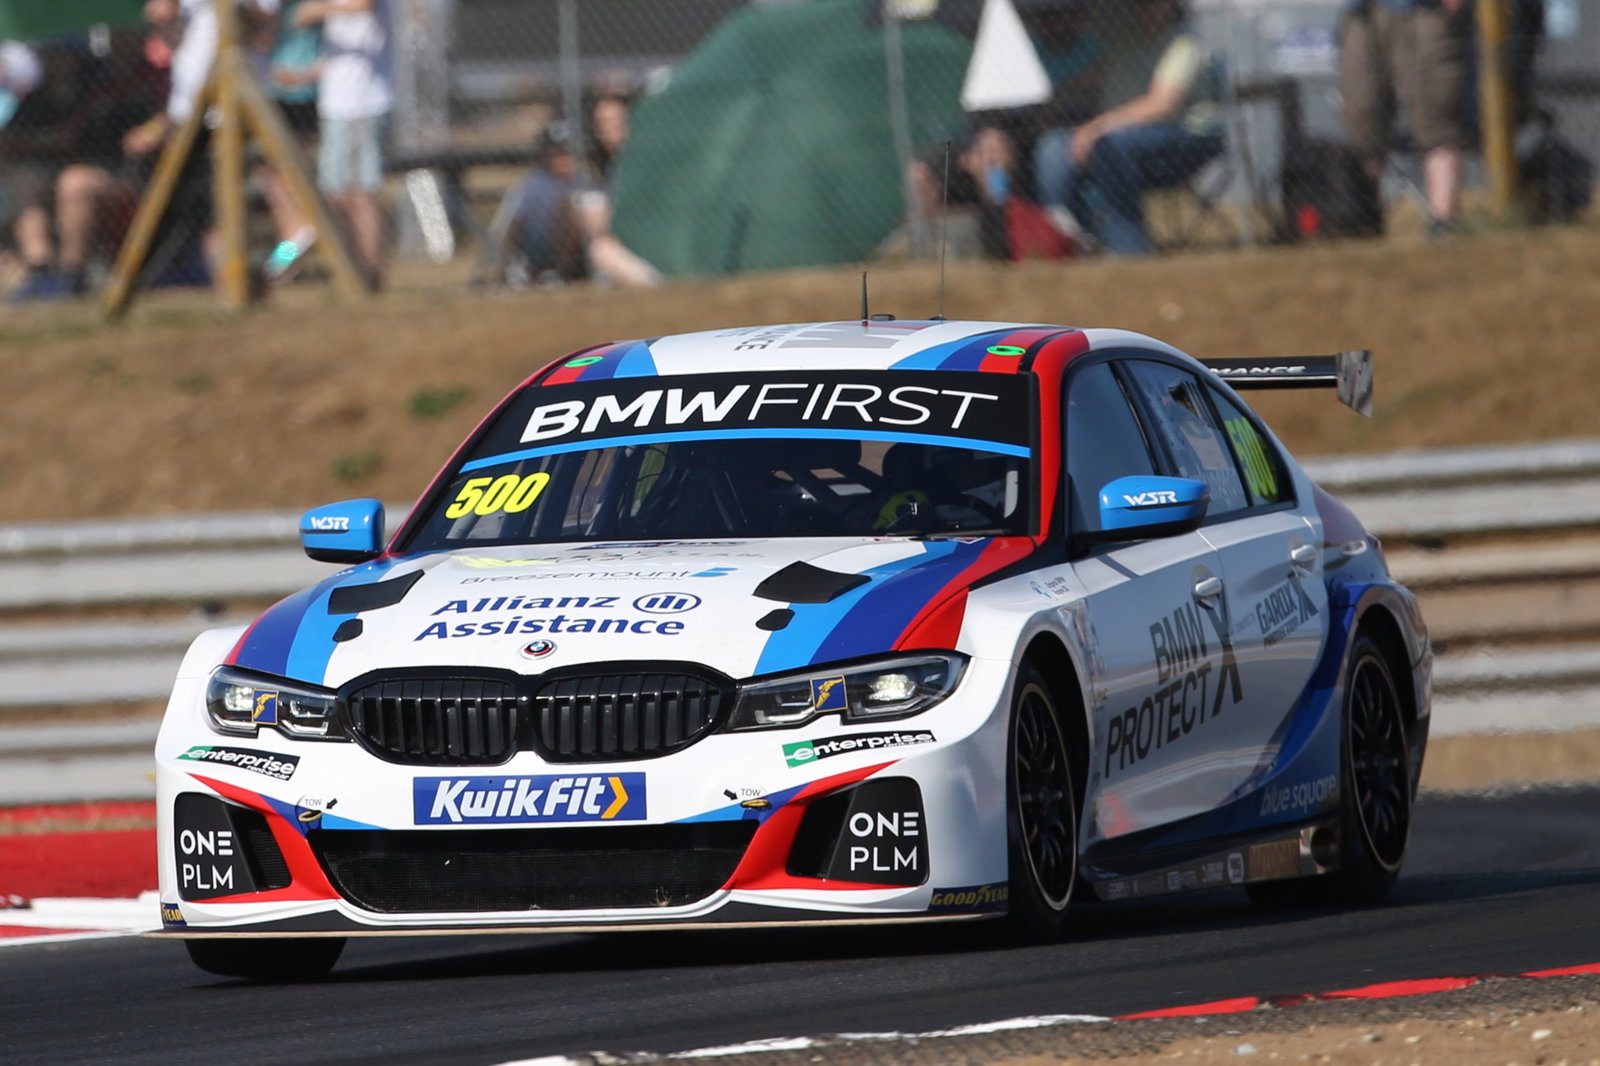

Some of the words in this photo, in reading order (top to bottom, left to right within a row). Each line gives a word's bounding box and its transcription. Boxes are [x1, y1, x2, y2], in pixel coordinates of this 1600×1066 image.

[445, 472, 550, 519] 500
[1122, 490, 1178, 506] WSR
[311, 517, 350, 530] WSR
[459, 568, 690, 585] Breezemount
[431, 595, 623, 615] Allianz
[414, 615, 685, 641] Assistance
[1149, 594, 1208, 686] BMW
[1104, 660, 1212, 779] PROTECT
[787, 732, 934, 761] enterprise
[187, 747, 295, 775] enterprise
[304, 799, 322, 807] TOW
[741, 788, 761, 797] TOW
[849, 811, 919, 837] ONE
[180, 830, 233, 856] ONE
[851, 846, 918, 871] PLM
[183, 864, 234, 889] PLM
